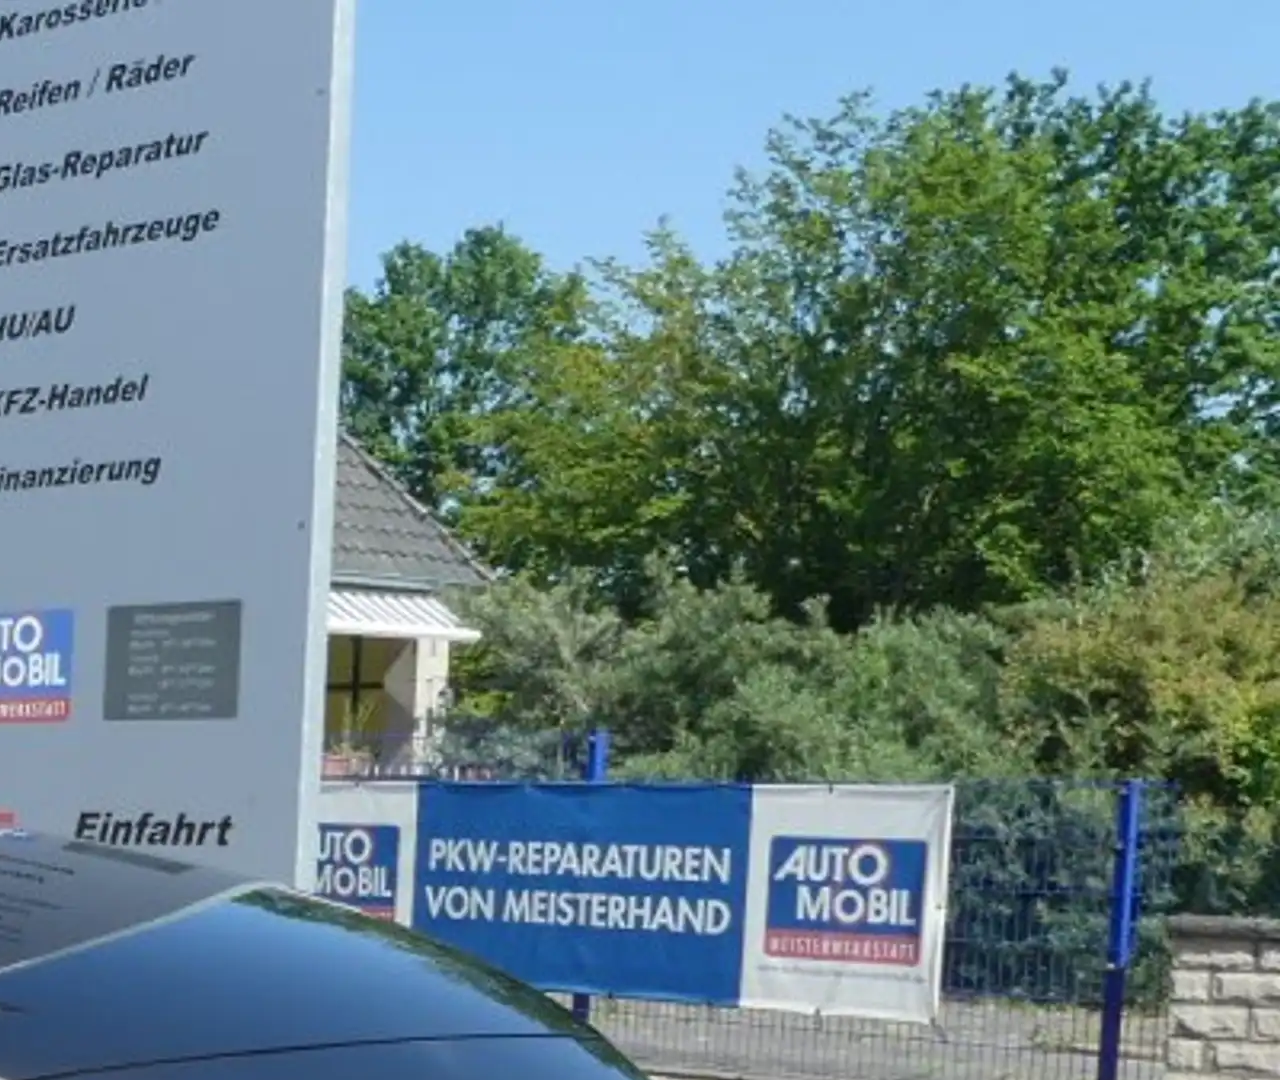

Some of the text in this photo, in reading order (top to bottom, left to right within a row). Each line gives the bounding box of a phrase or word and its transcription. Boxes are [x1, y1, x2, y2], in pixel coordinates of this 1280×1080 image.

[105, 54, 196, 93] Räder
[73, 810, 234, 847] Einfahrt
[317, 828, 372, 864] UTO
[428, 837, 732, 885] PKW-REPARATUREN
[772, 843, 889, 887] AUTO
[424, 885, 732, 936] VON MEISTERHAND
[795, 884, 917, 928] MOBIL
